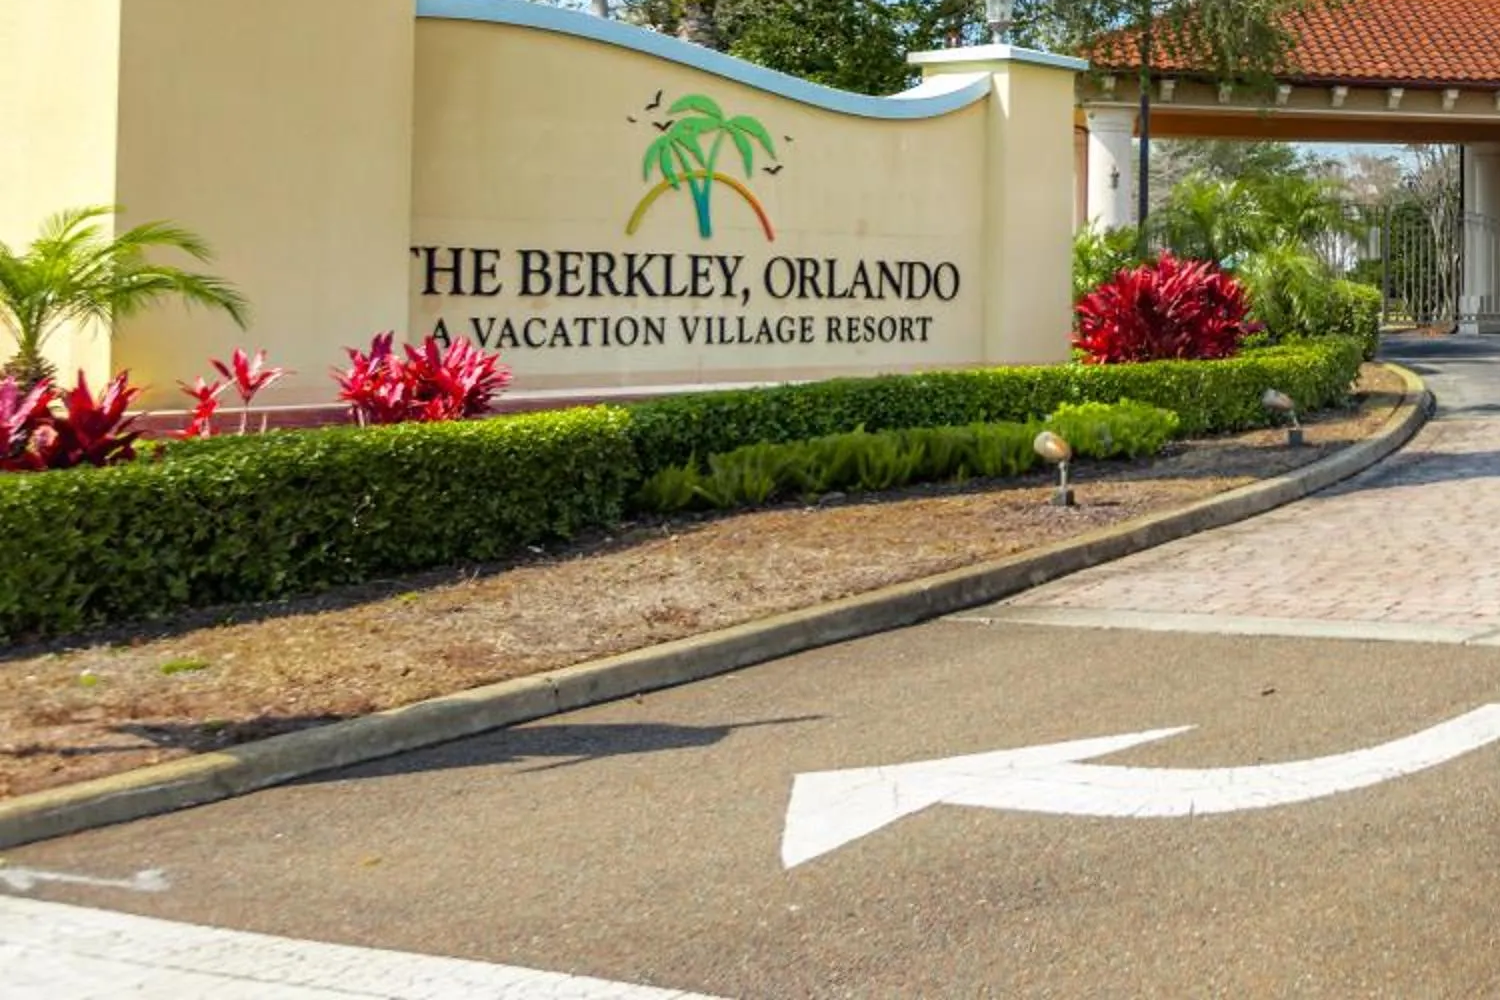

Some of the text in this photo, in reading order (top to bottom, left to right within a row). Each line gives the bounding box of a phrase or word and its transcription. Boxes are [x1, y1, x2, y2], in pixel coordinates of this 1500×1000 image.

[409, 246, 961, 307] HE BERKLEY, ORLANDO
[430, 315, 933, 349] A VACATION VILLAGE RESORT
